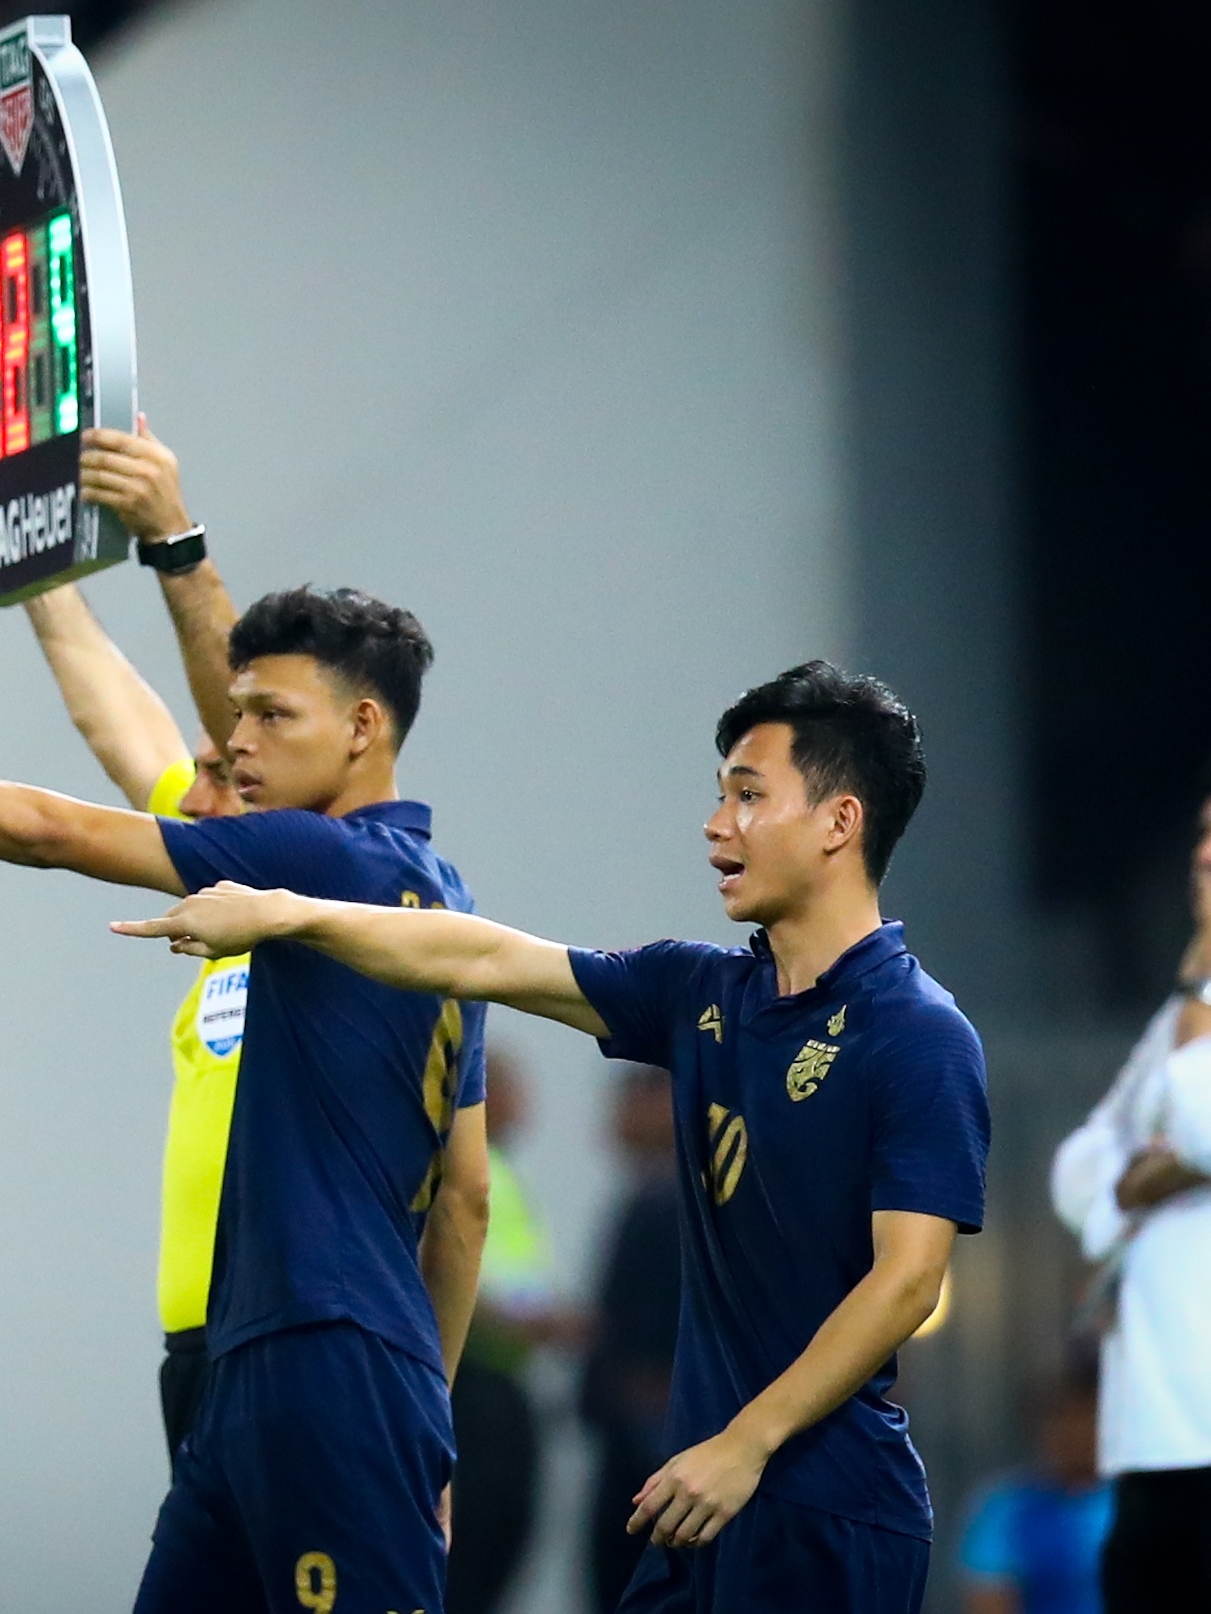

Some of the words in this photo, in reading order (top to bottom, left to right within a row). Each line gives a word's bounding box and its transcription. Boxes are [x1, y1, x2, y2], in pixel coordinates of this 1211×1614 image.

[49, 212, 79, 435] 9
[207, 970, 249, 998] FIFA
[295, 1551, 337, 1614] 9
